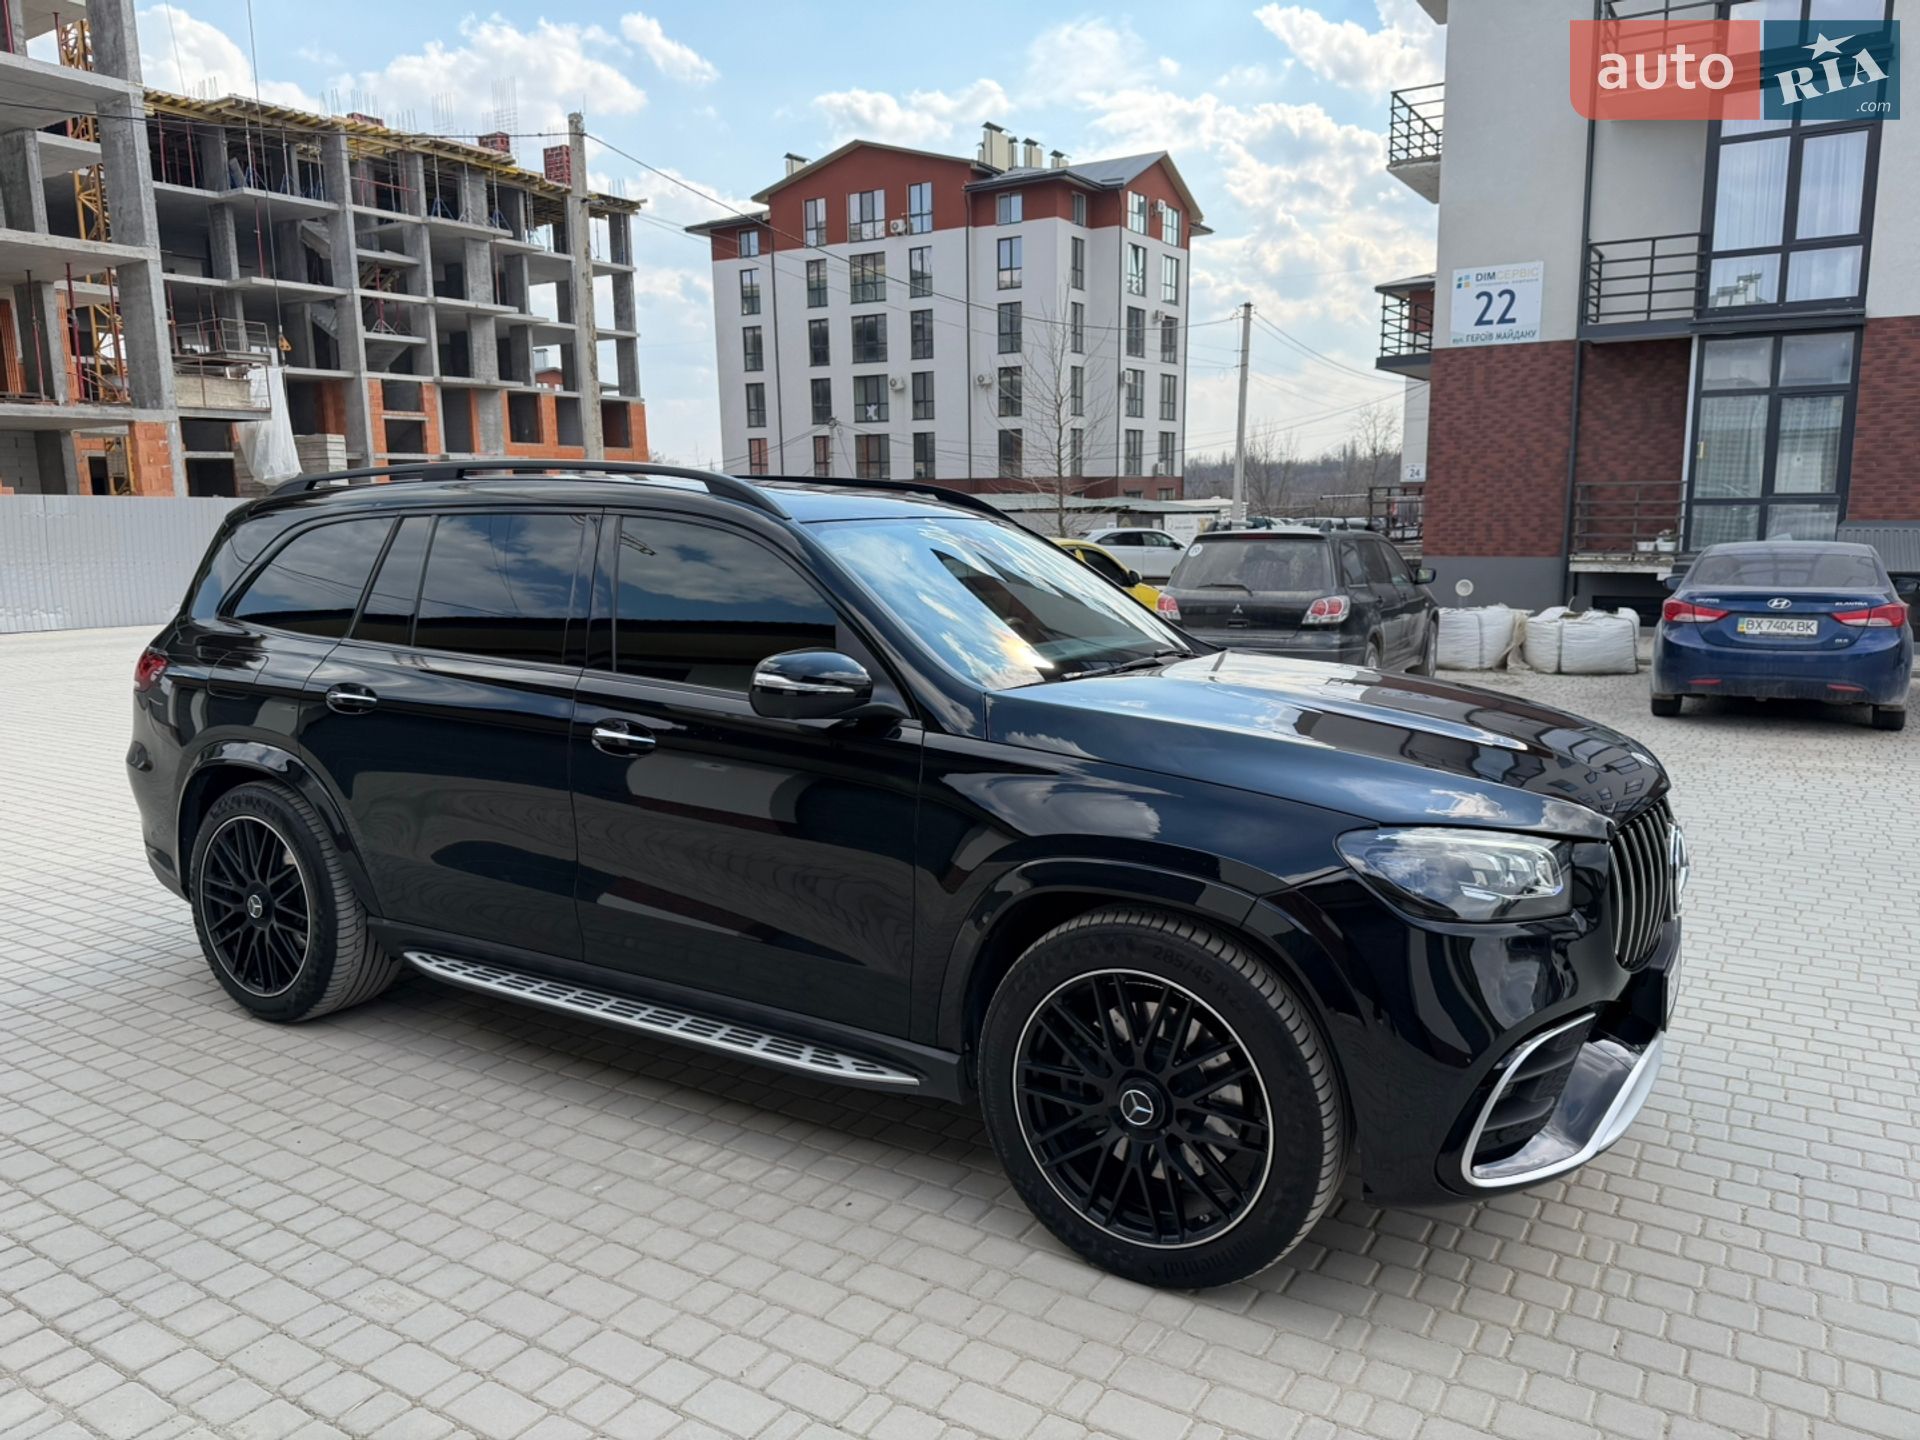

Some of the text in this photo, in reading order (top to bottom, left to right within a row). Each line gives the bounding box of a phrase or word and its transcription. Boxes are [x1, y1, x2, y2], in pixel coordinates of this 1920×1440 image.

[1474, 289, 1517, 326] 22
[1746, 618, 1815, 633] BX 7404 BK
[1151, 944, 1217, 985] 285/45
